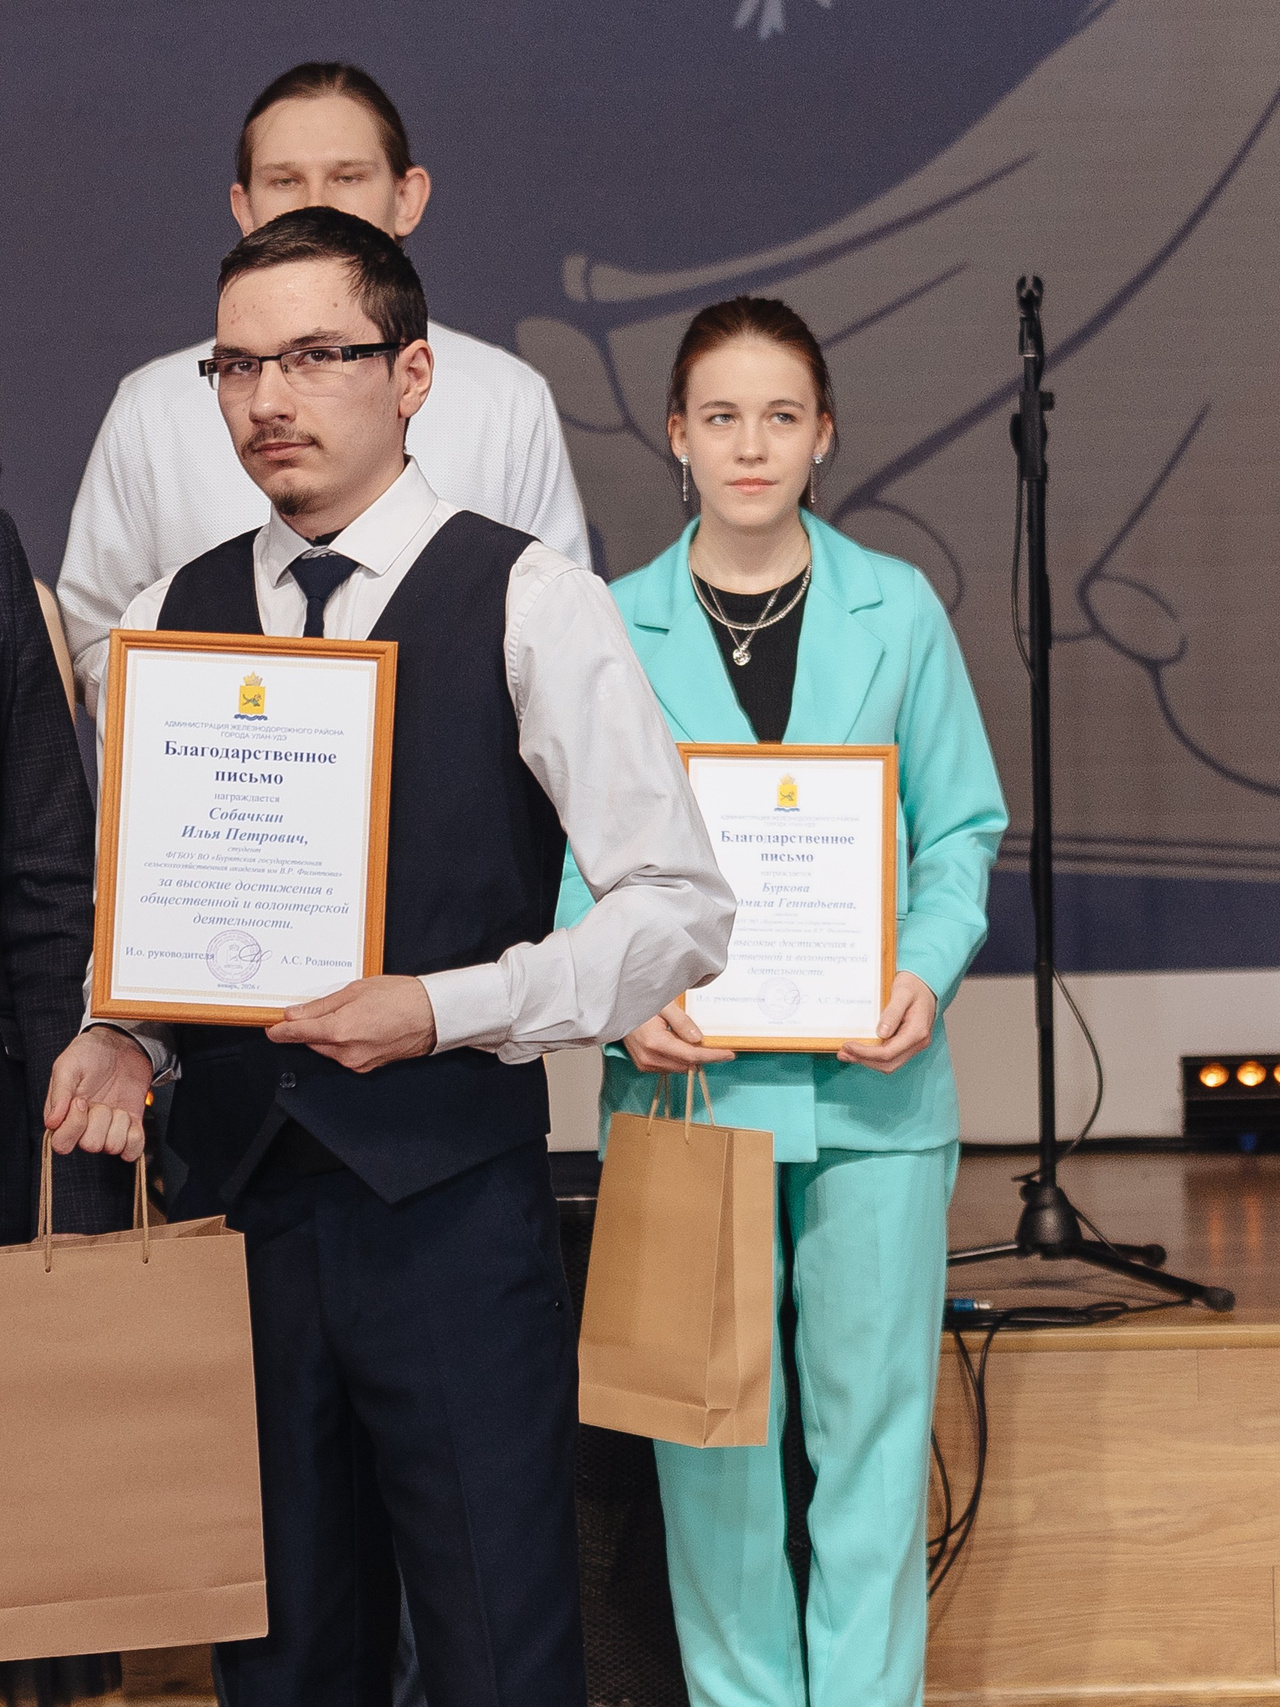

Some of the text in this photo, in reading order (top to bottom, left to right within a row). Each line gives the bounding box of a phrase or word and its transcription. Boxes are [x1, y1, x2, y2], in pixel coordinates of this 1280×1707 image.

[164, 720, 344, 736] АДМИНИСТРАЦИЯ ЖЕЛЕЗНОДОРОЖНОГО РАЙОНА
[252, 733, 287, 741] УЛАН-УДЭ
[164, 740, 338, 764] Благодарственное
[214, 769, 284, 785] письмо
[214, 792, 280, 804] награждается
[209, 807, 284, 823] Собачкин
[181, 825, 309, 847] Илья Петрович,
[721, 830, 855, 846] Благодарственное
[227, 846, 261, 854] студент
[760, 852, 814, 862] письмо
[165, 851, 322, 867] ФГБОУ ВО «Бурятская государственная
[158, 879, 333, 895] за высокие достижения в
[762, 882, 810, 894] Буркова
[140, 893, 349, 915] общественной и волонтерской
[193, 912, 293, 929] деятельности.
[733, 939, 776, 948] высокие
[779, 939, 846, 949] достижения
[126, 946, 215, 960] И.о. руководителя
[280, 954, 353, 968] А.С. Родионов
[794, 953, 868, 966] волонтерской
